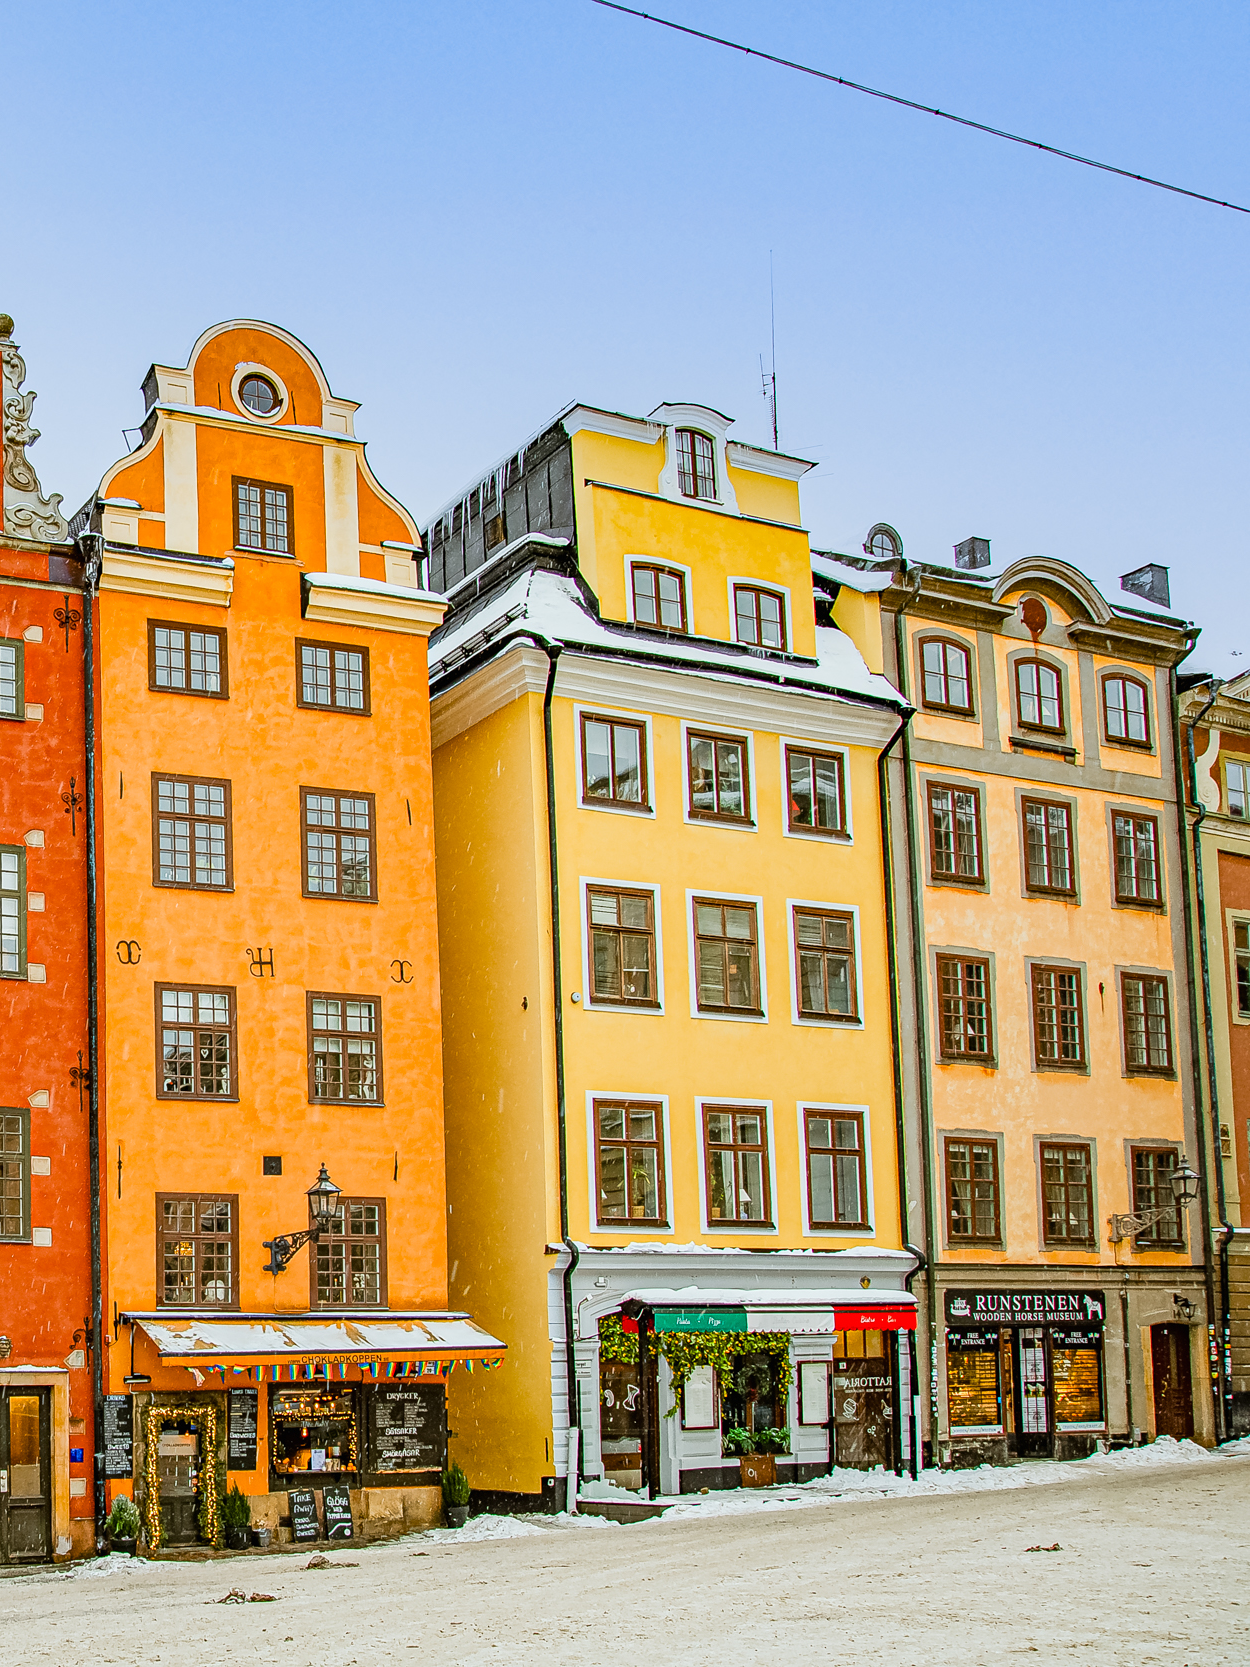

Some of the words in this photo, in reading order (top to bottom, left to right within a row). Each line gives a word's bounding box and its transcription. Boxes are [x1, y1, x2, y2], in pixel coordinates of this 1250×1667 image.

[975, 1295, 1079, 1311] RUNSTENEN
[973, 1312, 1012, 1321] WOODEN
[1015, 1312, 1044, 1321] HORSE
[1046, 1311, 1084, 1321] MUSEUM
[301, 1354, 382, 1364] CHOKLADKOPPEN
[386, 1392, 420, 1401] DRYCKER
[326, 1495, 349, 1507] GLÖGG
[293, 1503, 315, 1517] AWAY
